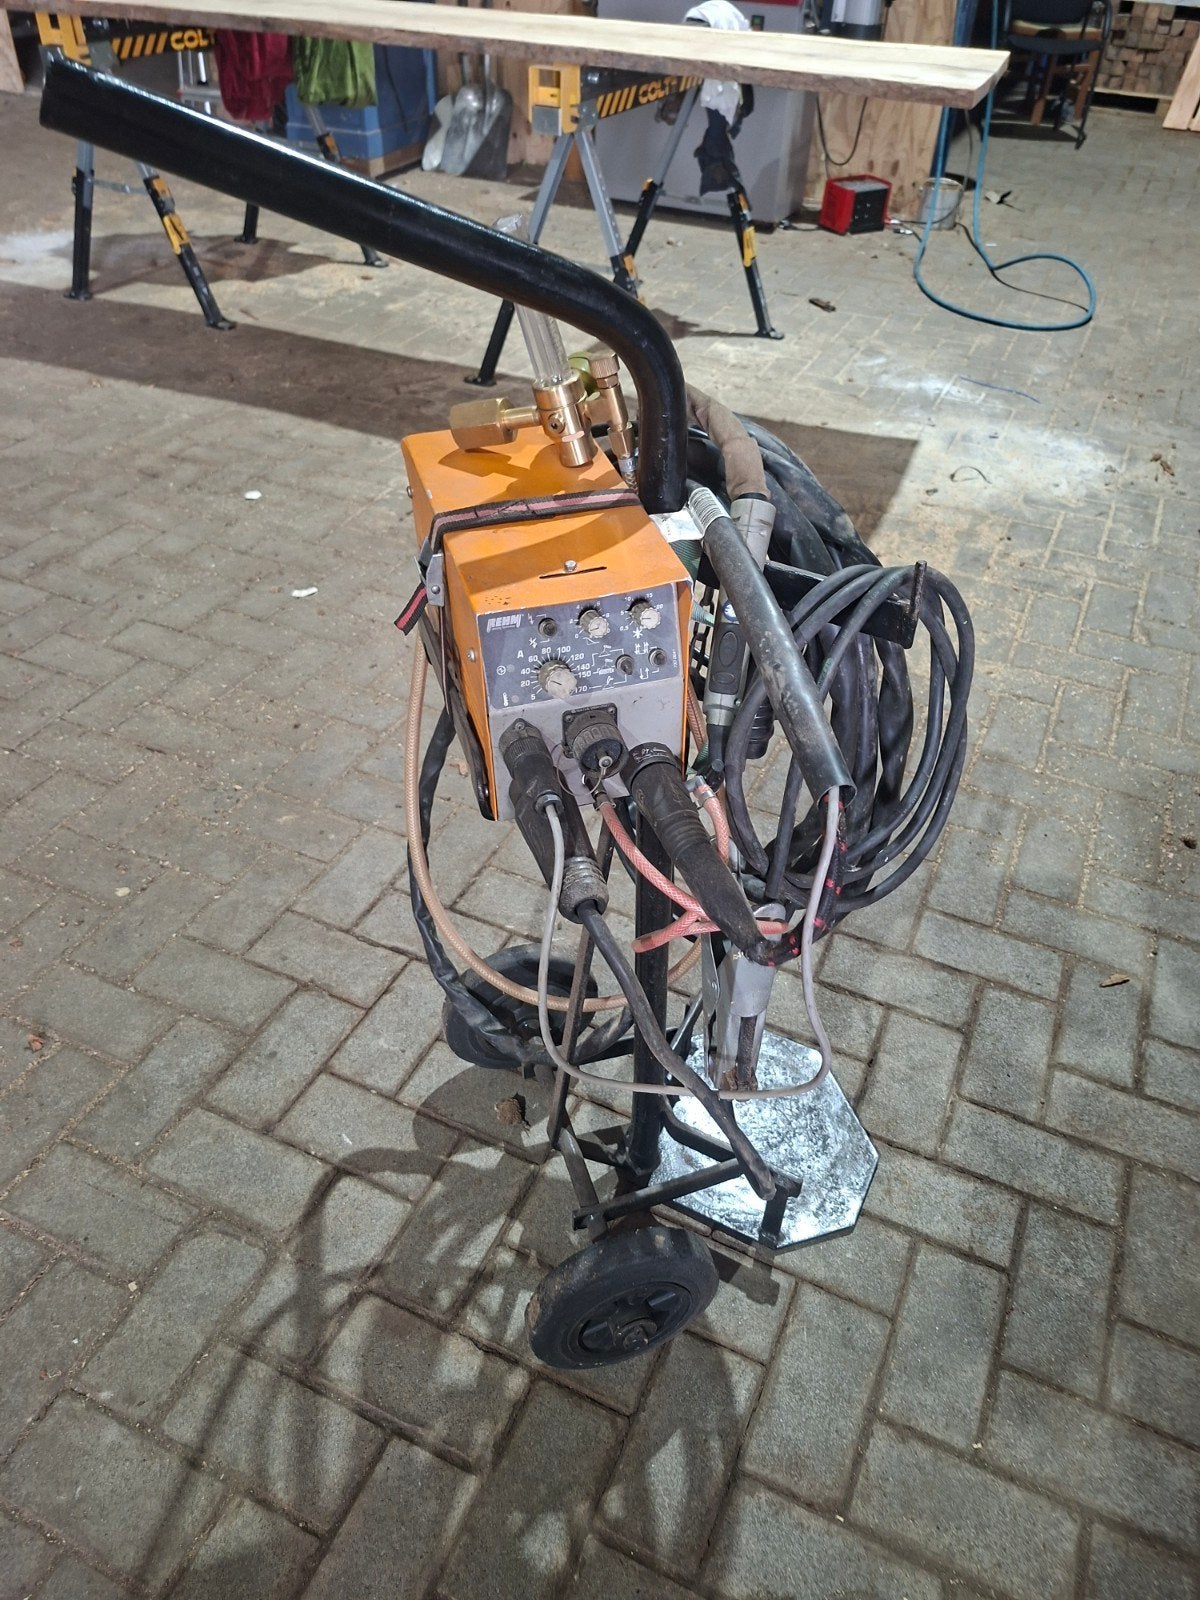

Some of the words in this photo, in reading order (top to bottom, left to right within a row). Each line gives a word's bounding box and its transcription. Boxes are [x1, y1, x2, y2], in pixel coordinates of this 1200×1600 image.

[486, 613, 523, 634] REHM
[541, 646, 551, 654] 80
[556, 645, 571, 654] 100
[516, 649, 524, 659] A
[528, 654, 538, 662] 60
[570, 652, 585, 661] 120
[520, 667, 531, 675] 40
[576, 663, 590, 671] 140
[578, 670, 592, 679] 150
[520, 679, 531, 688] 20
[574, 685, 588, 693] 170
[530, 693, 536, 701] 5
